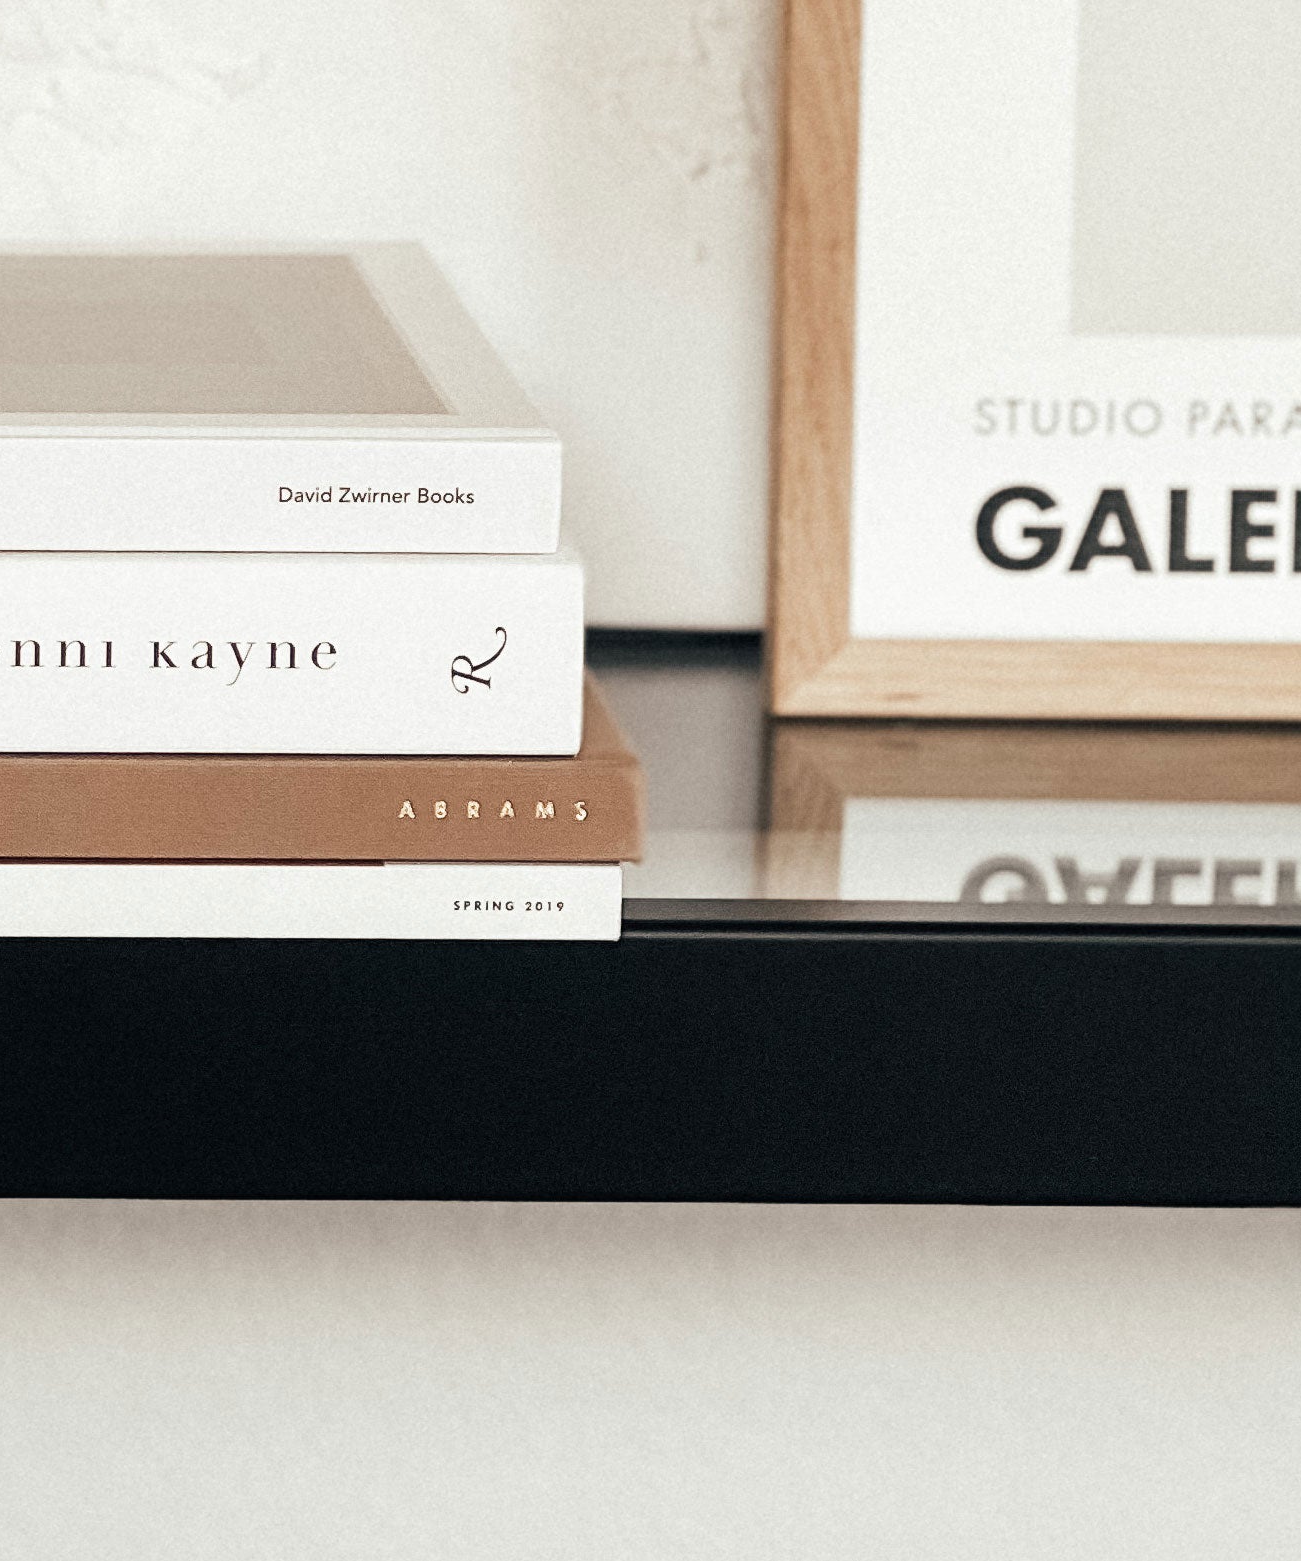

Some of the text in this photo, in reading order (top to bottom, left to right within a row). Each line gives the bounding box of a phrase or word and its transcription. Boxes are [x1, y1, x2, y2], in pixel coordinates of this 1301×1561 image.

[974, 397, 1163, 438] STUDIO
[278, 485, 475, 505] David Zwirner Books
[975, 484, 1301, 574] GALE
[398, 798, 589, 821] ABRAMS
[453, 900, 566, 913] SPRING 2019
